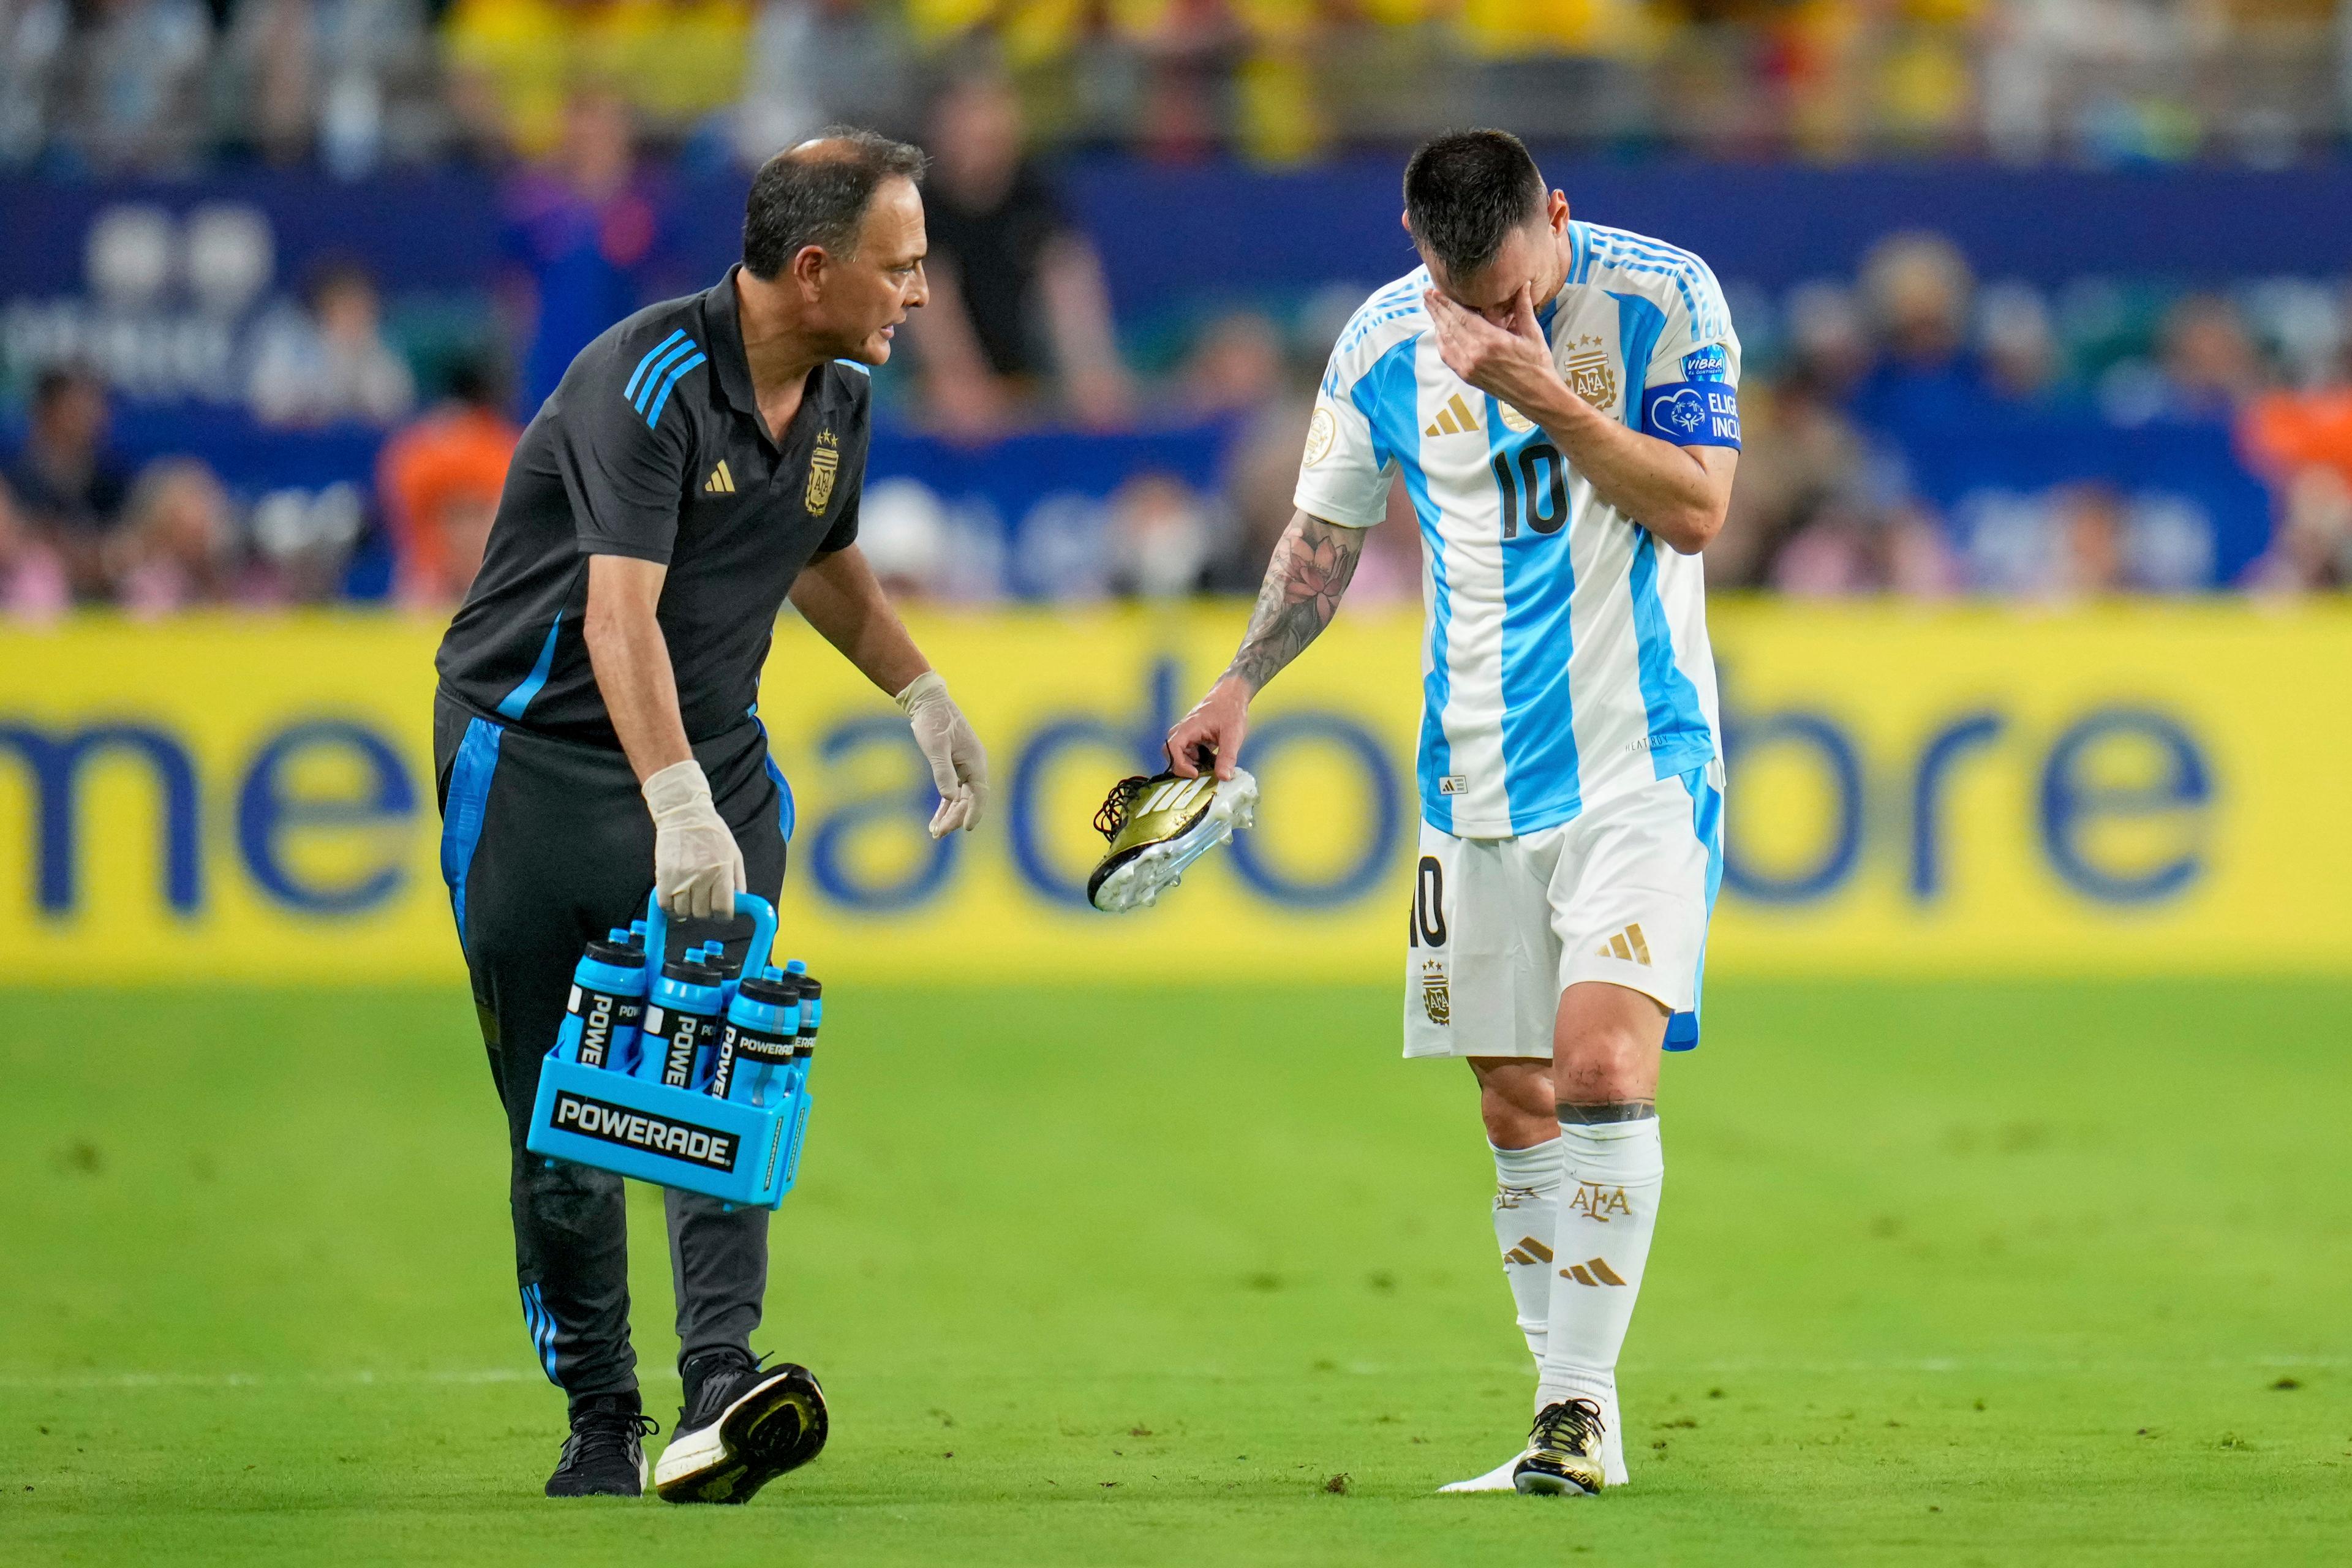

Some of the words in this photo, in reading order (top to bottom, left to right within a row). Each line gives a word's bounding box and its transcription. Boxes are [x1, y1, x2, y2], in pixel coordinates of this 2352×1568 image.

[1577, 368, 1605, 396] AFA
[1688, 358, 1722, 370] VIBRA
[1493, 444, 1569, 539] 10
[581, 994, 612, 1069] POWE
[665, 1015, 697, 1090] POWE
[711, 1025, 737, 1101] POWE
[1569, 1180, 1632, 1223] AFA
[1562, 1468, 1590, 1485] F50
